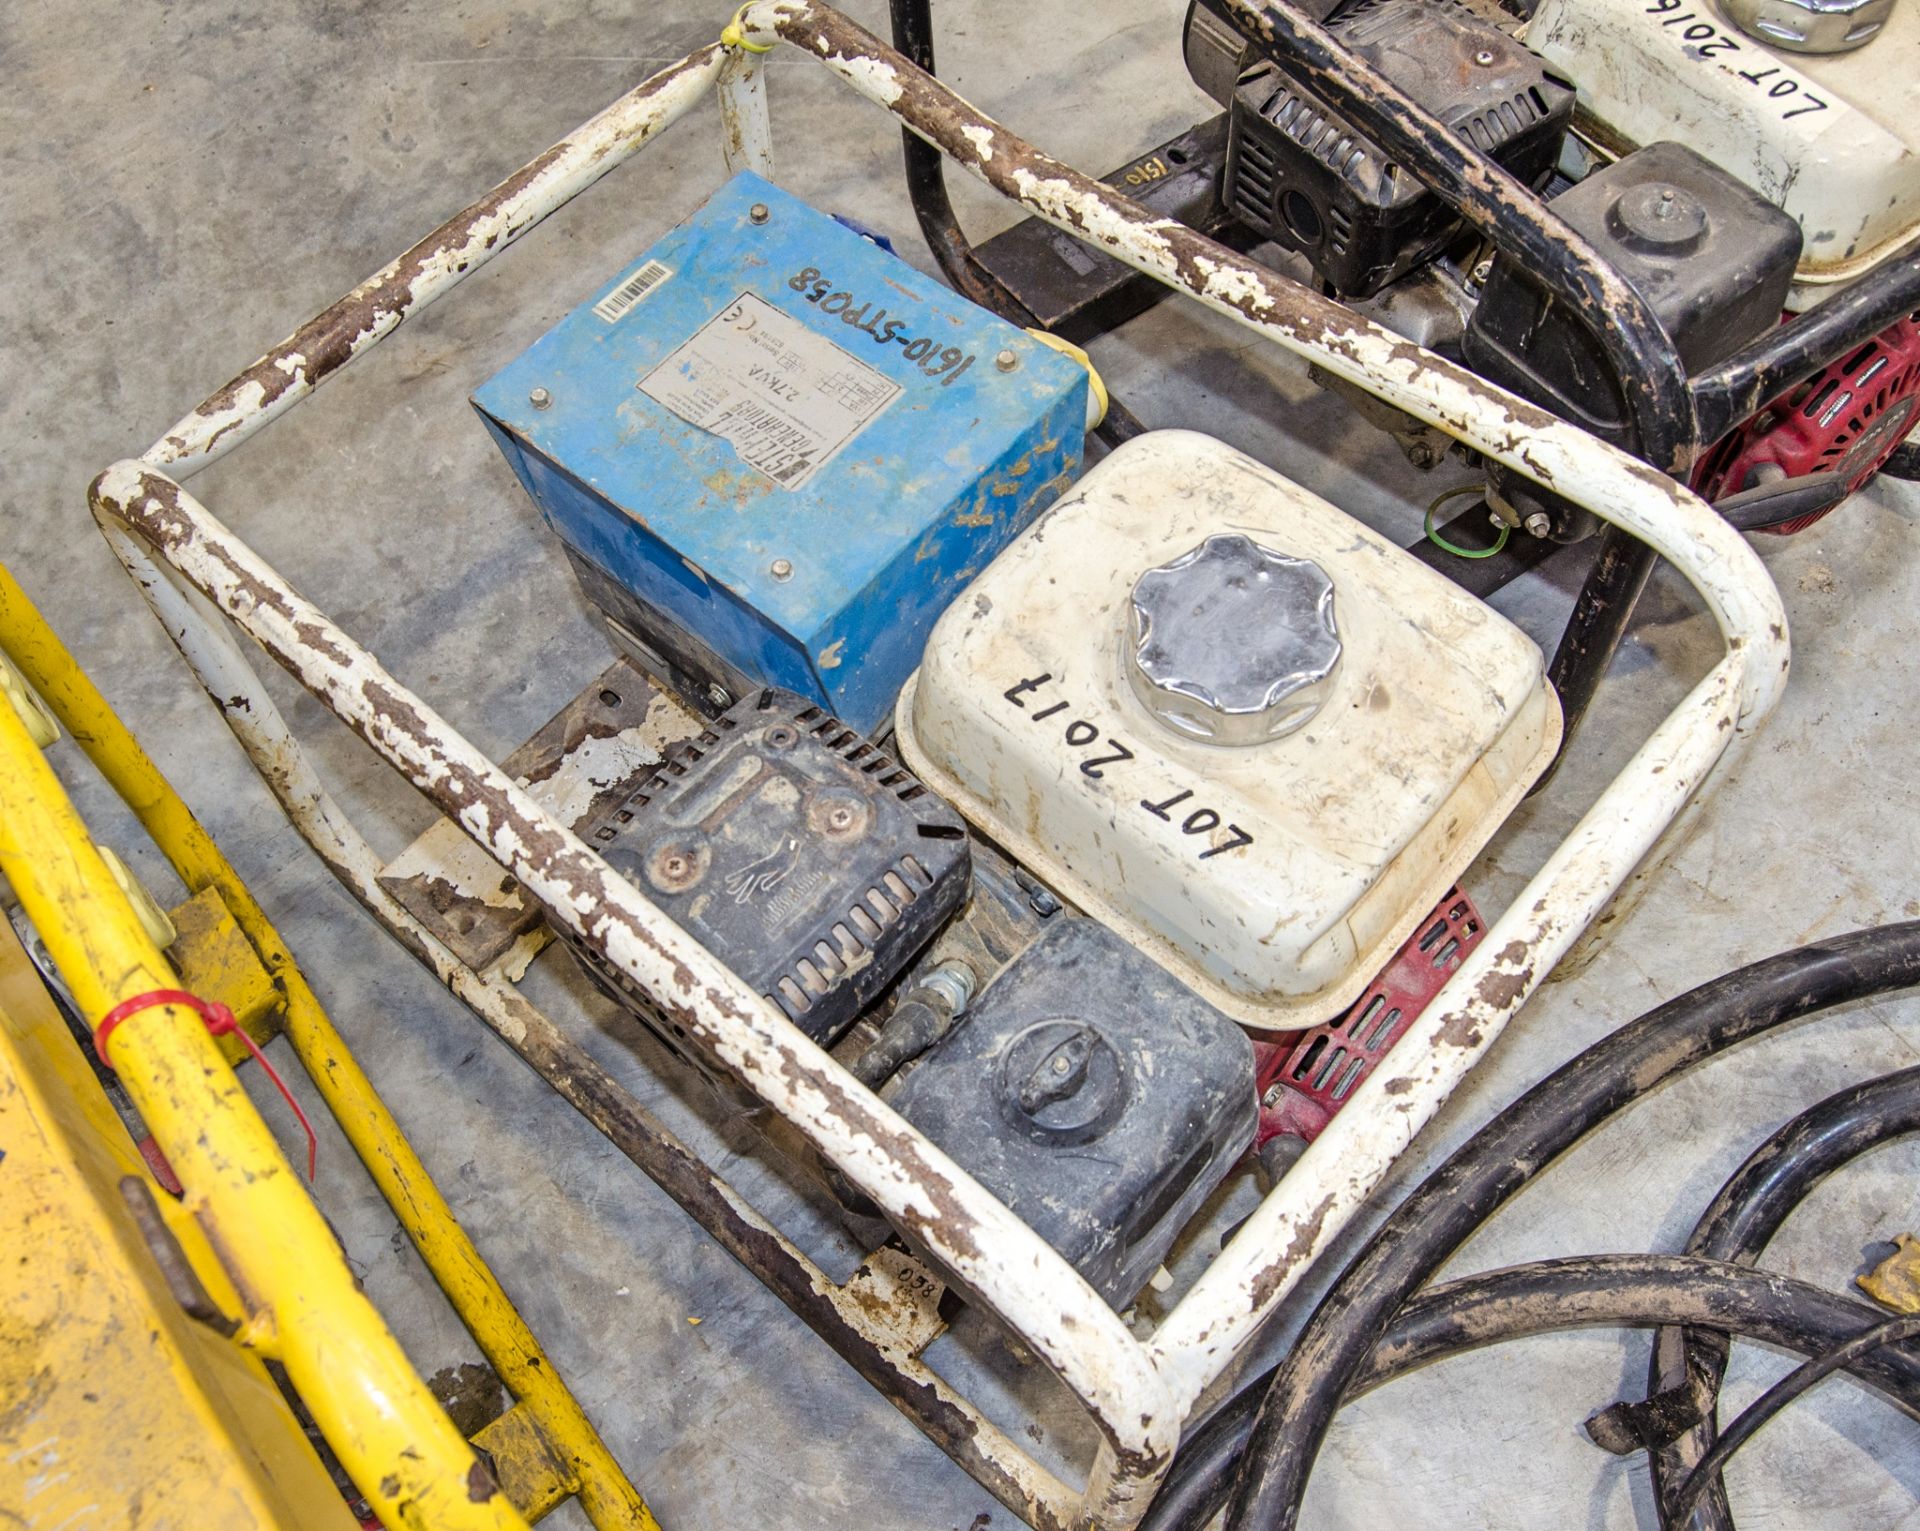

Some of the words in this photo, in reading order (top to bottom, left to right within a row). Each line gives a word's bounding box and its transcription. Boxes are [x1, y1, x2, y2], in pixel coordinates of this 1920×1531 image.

[1646, 0, 1740, 57] 2016
[1738, 68, 1828, 119] LOT
[743, 362, 802, 403] 2.7kVA
[729, 398, 813, 454] GENERATORS
[1003, 672, 1134, 779] 2017
[1140, 789, 1253, 859] LOT
